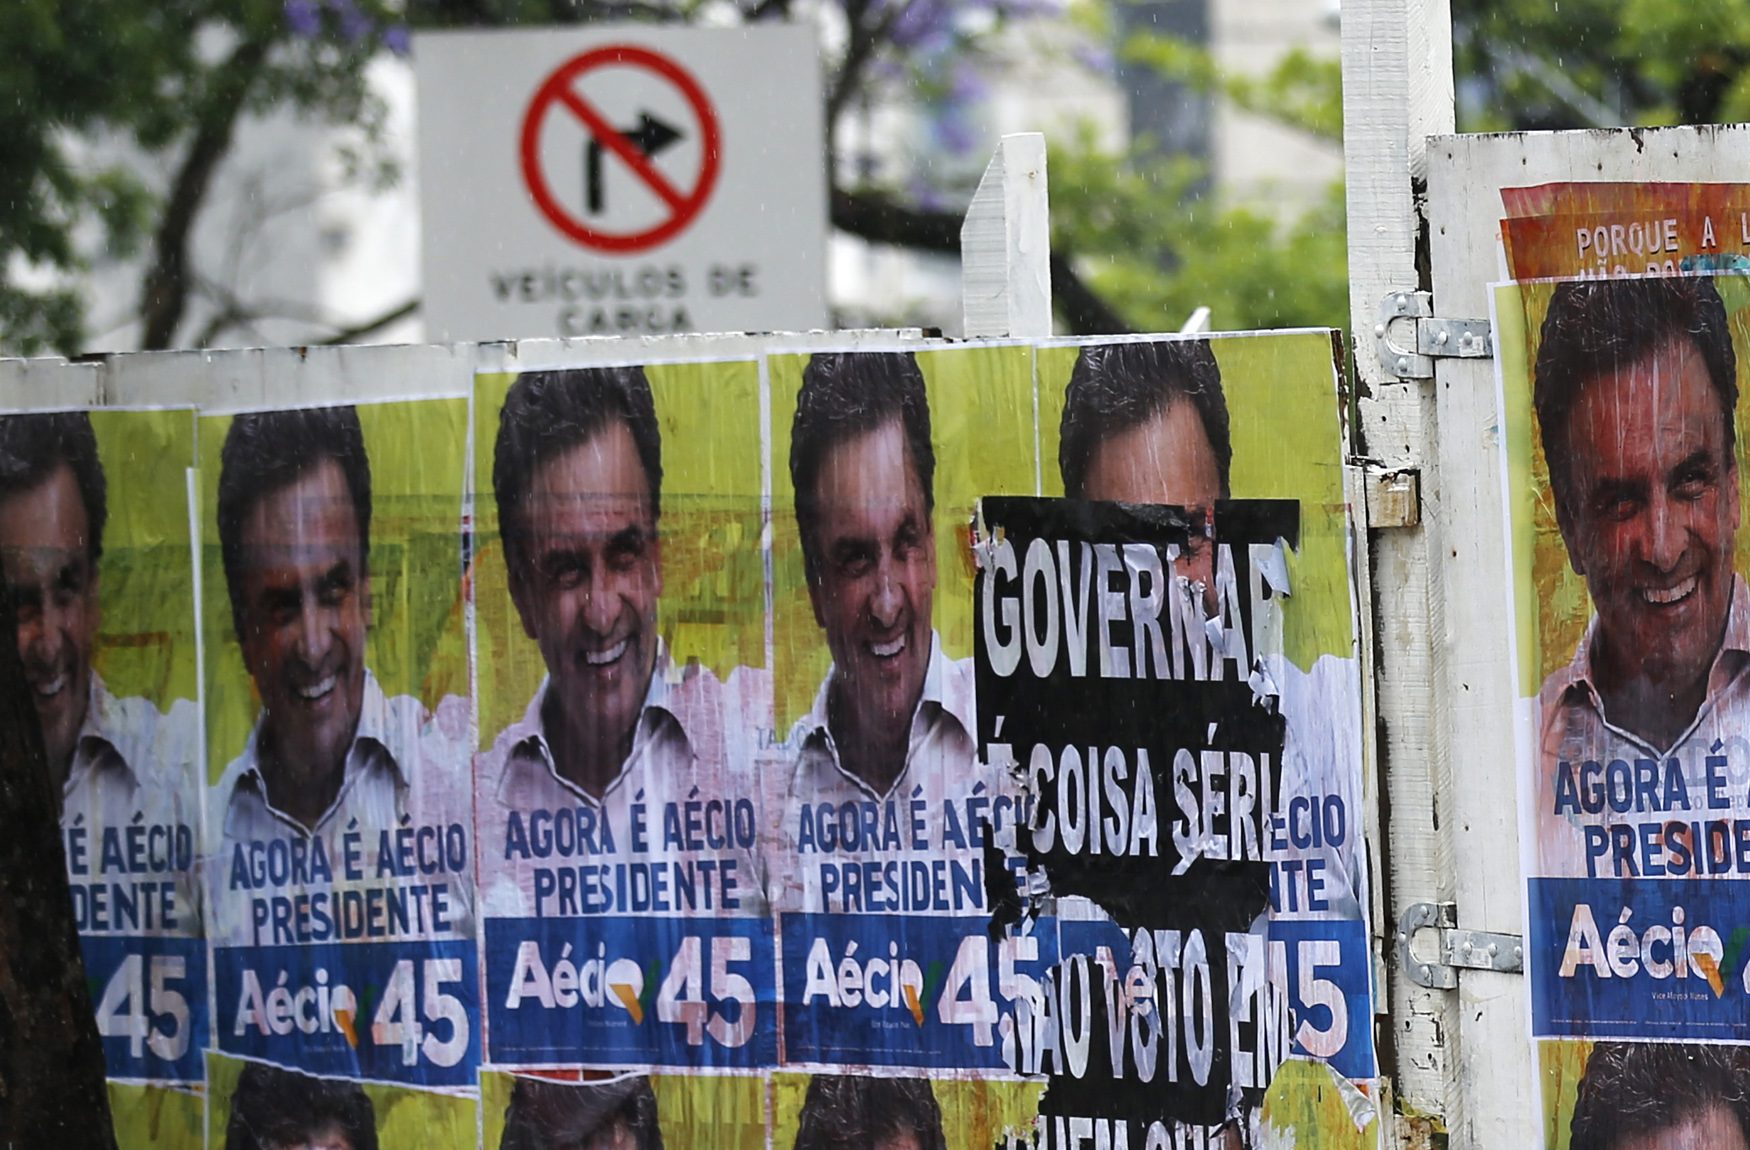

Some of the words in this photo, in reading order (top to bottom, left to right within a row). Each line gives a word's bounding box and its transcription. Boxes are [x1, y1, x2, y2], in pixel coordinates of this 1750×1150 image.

[1576, 217, 1679, 260] PORQUE
[1701, 214, 1718, 249] A
[488, 262, 688, 302] VEÍCULOS
[706, 262, 761, 298] DE
[556, 304, 694, 336] CARGA
[1028, 742, 1159, 857] COISA
[1172, 723, 1270, 863] SÉRI
[1553, 756, 1691, 816] AGORA
[1705, 737, 1731, 810] É
[68, 812, 89, 876] É
[101, 810, 194, 875] AÉCIO
[229, 836, 333, 891] AGORA
[343, 817, 363, 881] É
[377, 812, 467, 878] AÉCIO
[504, 805, 617, 860] AGORA
[631, 787, 649, 853] É
[663, 785, 756, 850] AÉCIO
[797, 800, 901, 854] AGORA
[910, 783, 929, 851] É
[252, 884, 452, 946] PRESIDENTE
[533, 859, 741, 917] PRESIDENTE
[819, 858, 1031, 914] PRESIDENE
[1557, 903, 1725, 980] Aécio
[95, 953, 191, 1062] 45
[233, 968, 358, 1038] Aécio
[371, 958, 470, 1068] 45
[505, 941, 645, 1010] Aécio
[656, 936, 757, 1049] 45
[802, 937, 924, 1009] Aécio
[936, 934, 1044, 1050] 45
